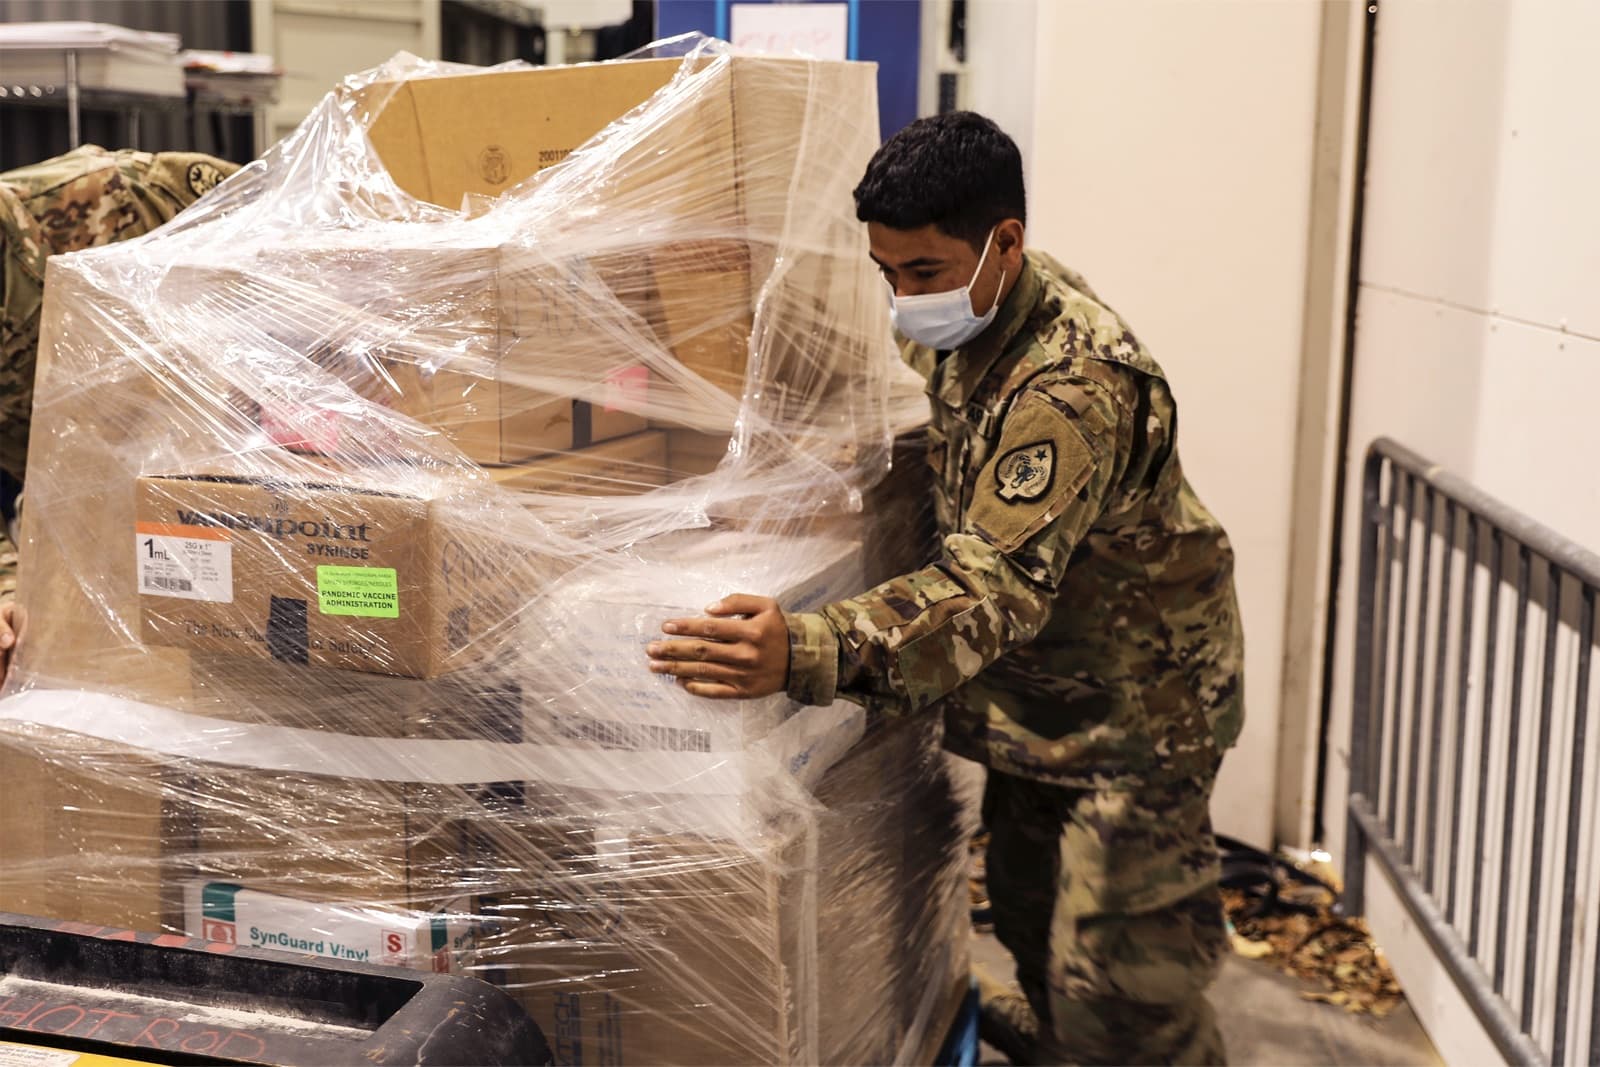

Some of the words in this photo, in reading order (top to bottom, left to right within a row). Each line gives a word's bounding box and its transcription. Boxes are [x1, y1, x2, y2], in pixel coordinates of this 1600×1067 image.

[306, 542, 369, 560] SYRINGE
[321, 590, 361, 599] PANDEMIC
[362, 592, 397, 601] VACCINE
[326, 599, 393, 609] ADMINISTRATION
[250, 926, 324, 954] SynGuard
[387, 933, 403, 954] S
[0, 1000, 140, 1038] HOT
